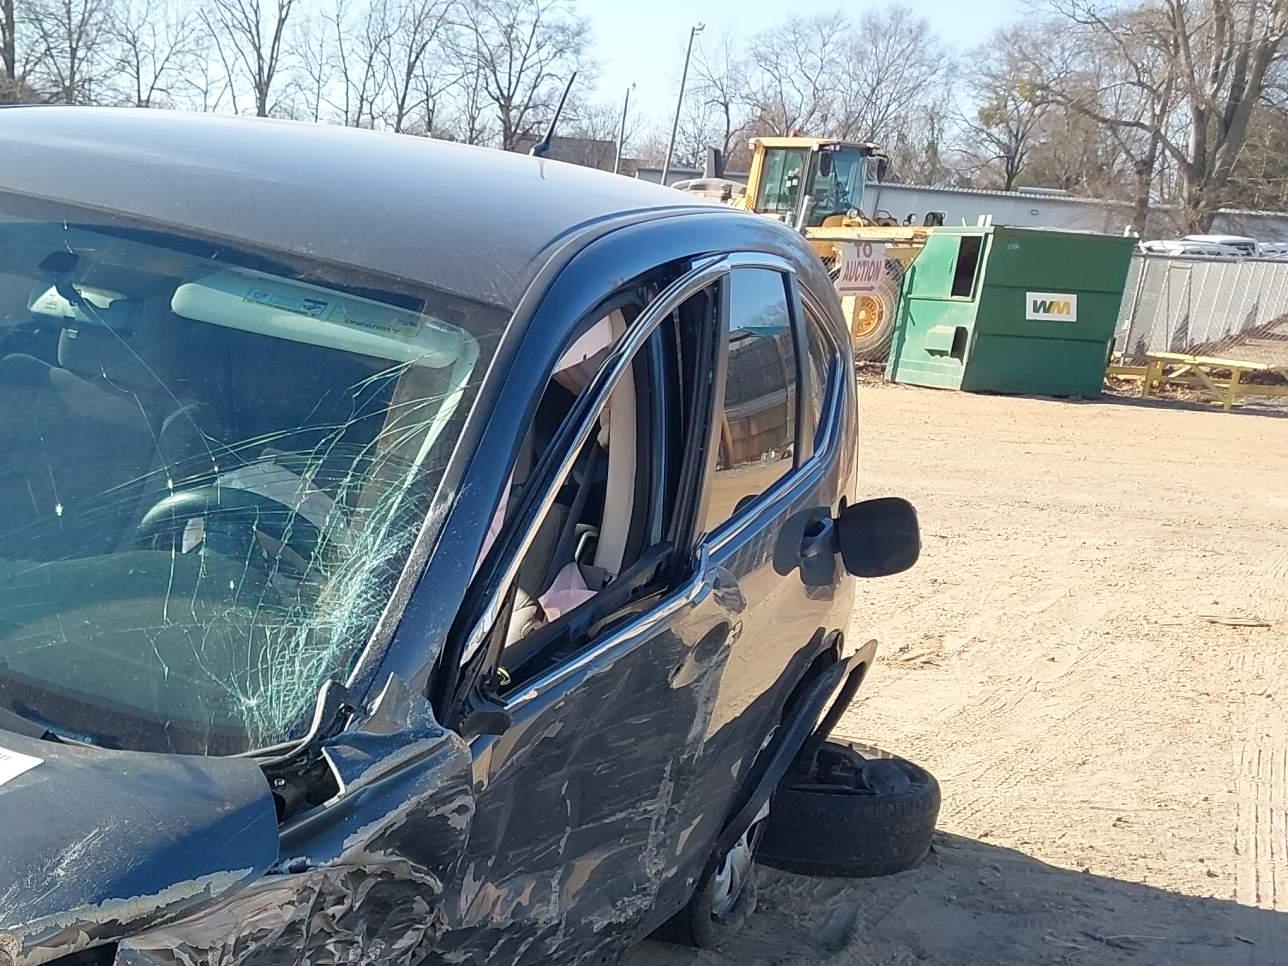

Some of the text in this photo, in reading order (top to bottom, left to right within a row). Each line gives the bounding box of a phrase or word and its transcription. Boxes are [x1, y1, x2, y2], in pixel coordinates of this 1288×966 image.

[854, 242, 873, 258] TO
[843, 260, 882, 282] AUCTION
[1032, 299, 1071, 315] WM
